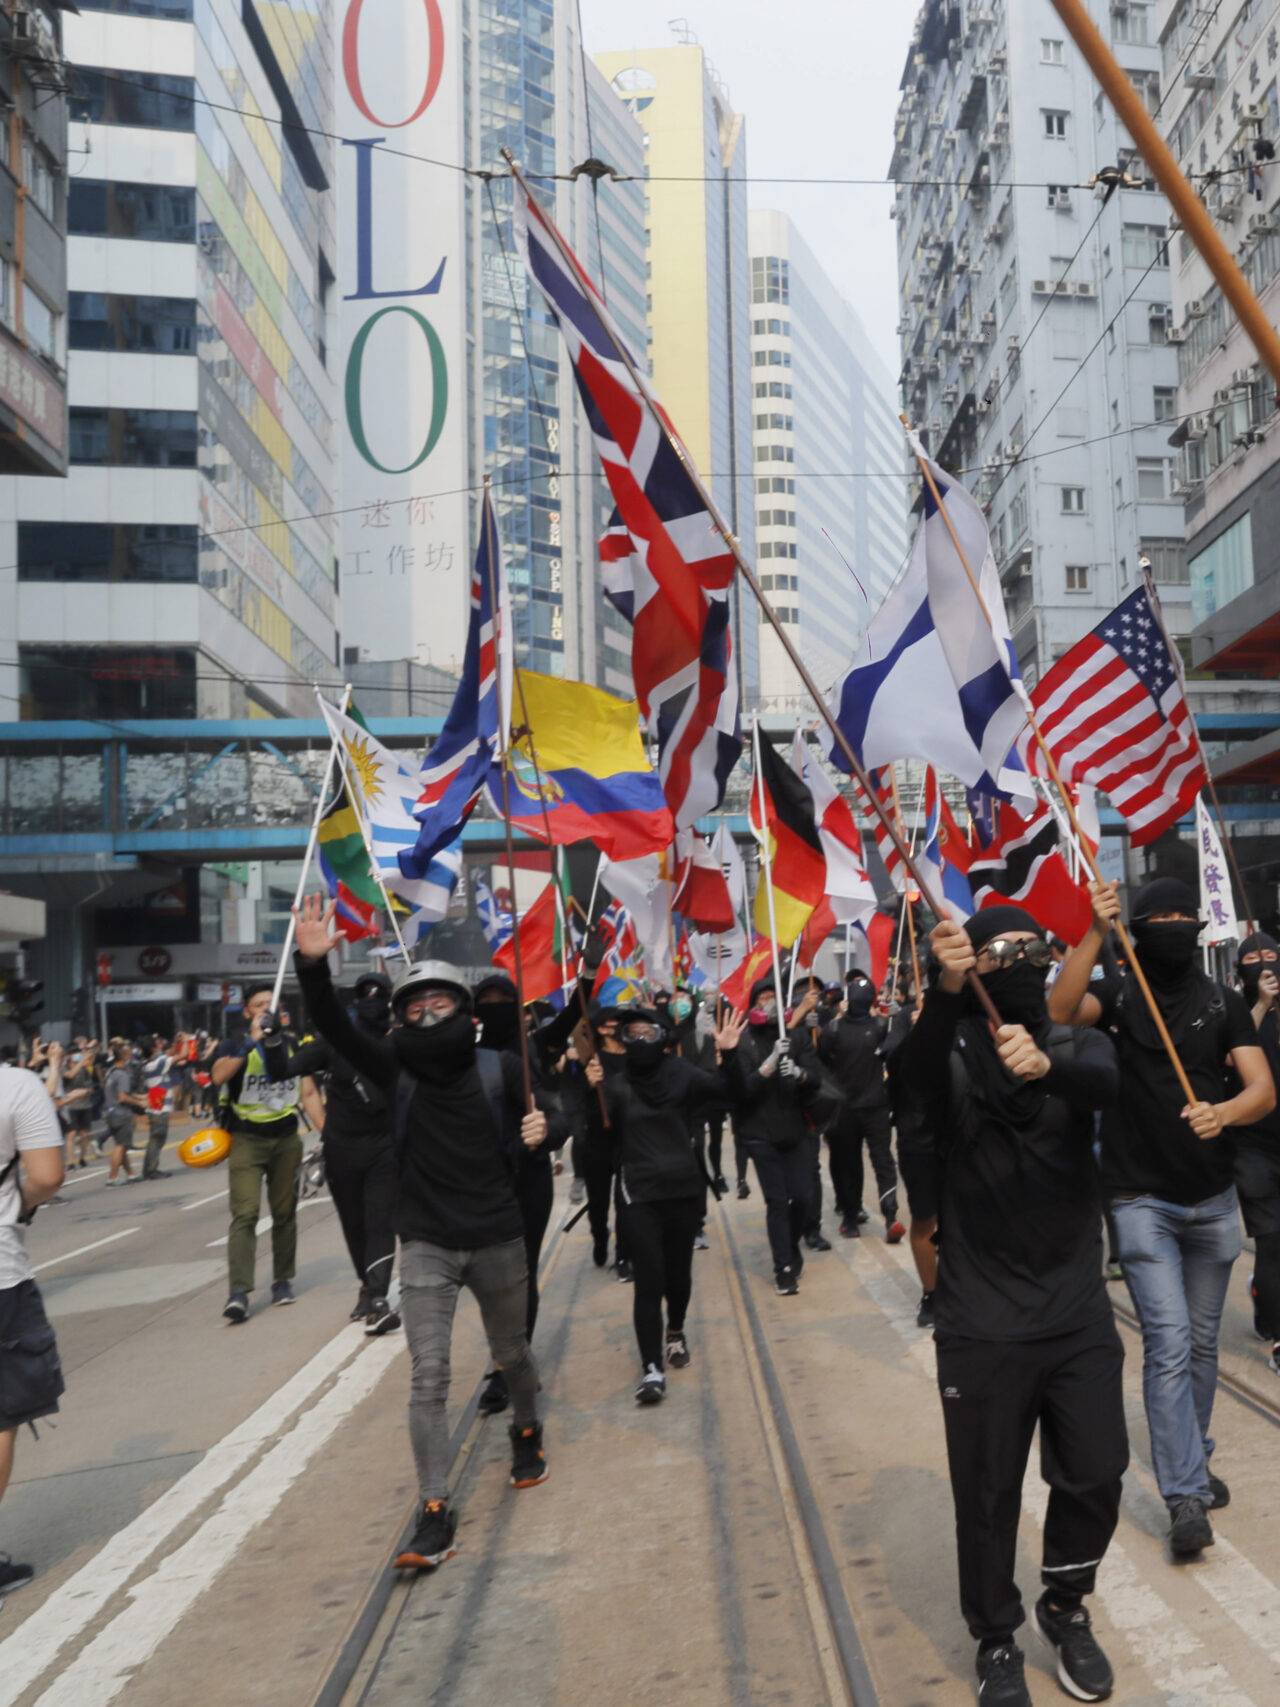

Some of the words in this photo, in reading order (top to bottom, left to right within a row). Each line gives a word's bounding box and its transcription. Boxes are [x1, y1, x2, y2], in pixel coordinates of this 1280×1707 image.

[361, 496, 435, 528] 迷你
[343, 542, 455, 575] 工作坊
